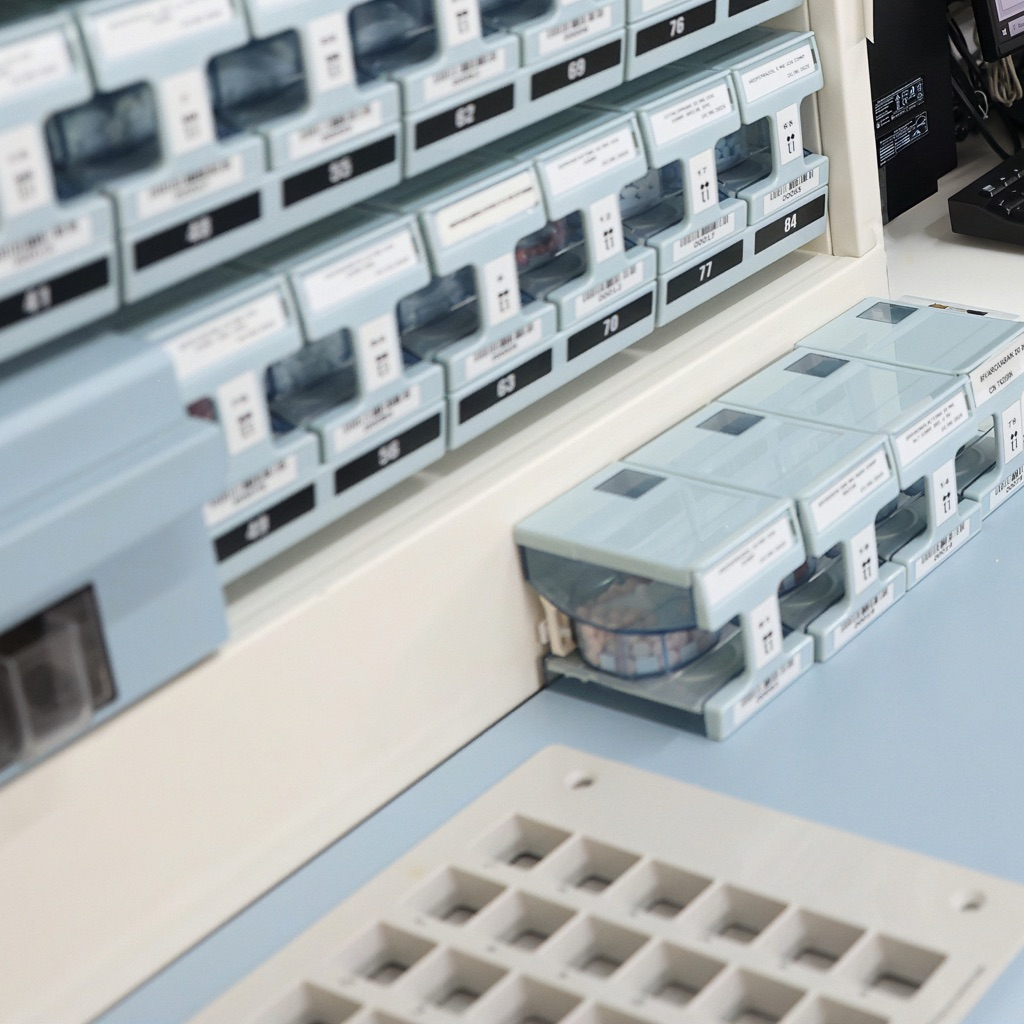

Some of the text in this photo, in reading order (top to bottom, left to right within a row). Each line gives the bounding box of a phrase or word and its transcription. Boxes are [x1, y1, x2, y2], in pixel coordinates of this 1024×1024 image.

[670, 17, 684, 36] 76
[568, 58, 586, 80] 69
[785, 214, 796, 232] 84
[699, 261, 712, 281] 77
[603, 314, 619, 336] 70
[497, 374, 515, 397] 63
